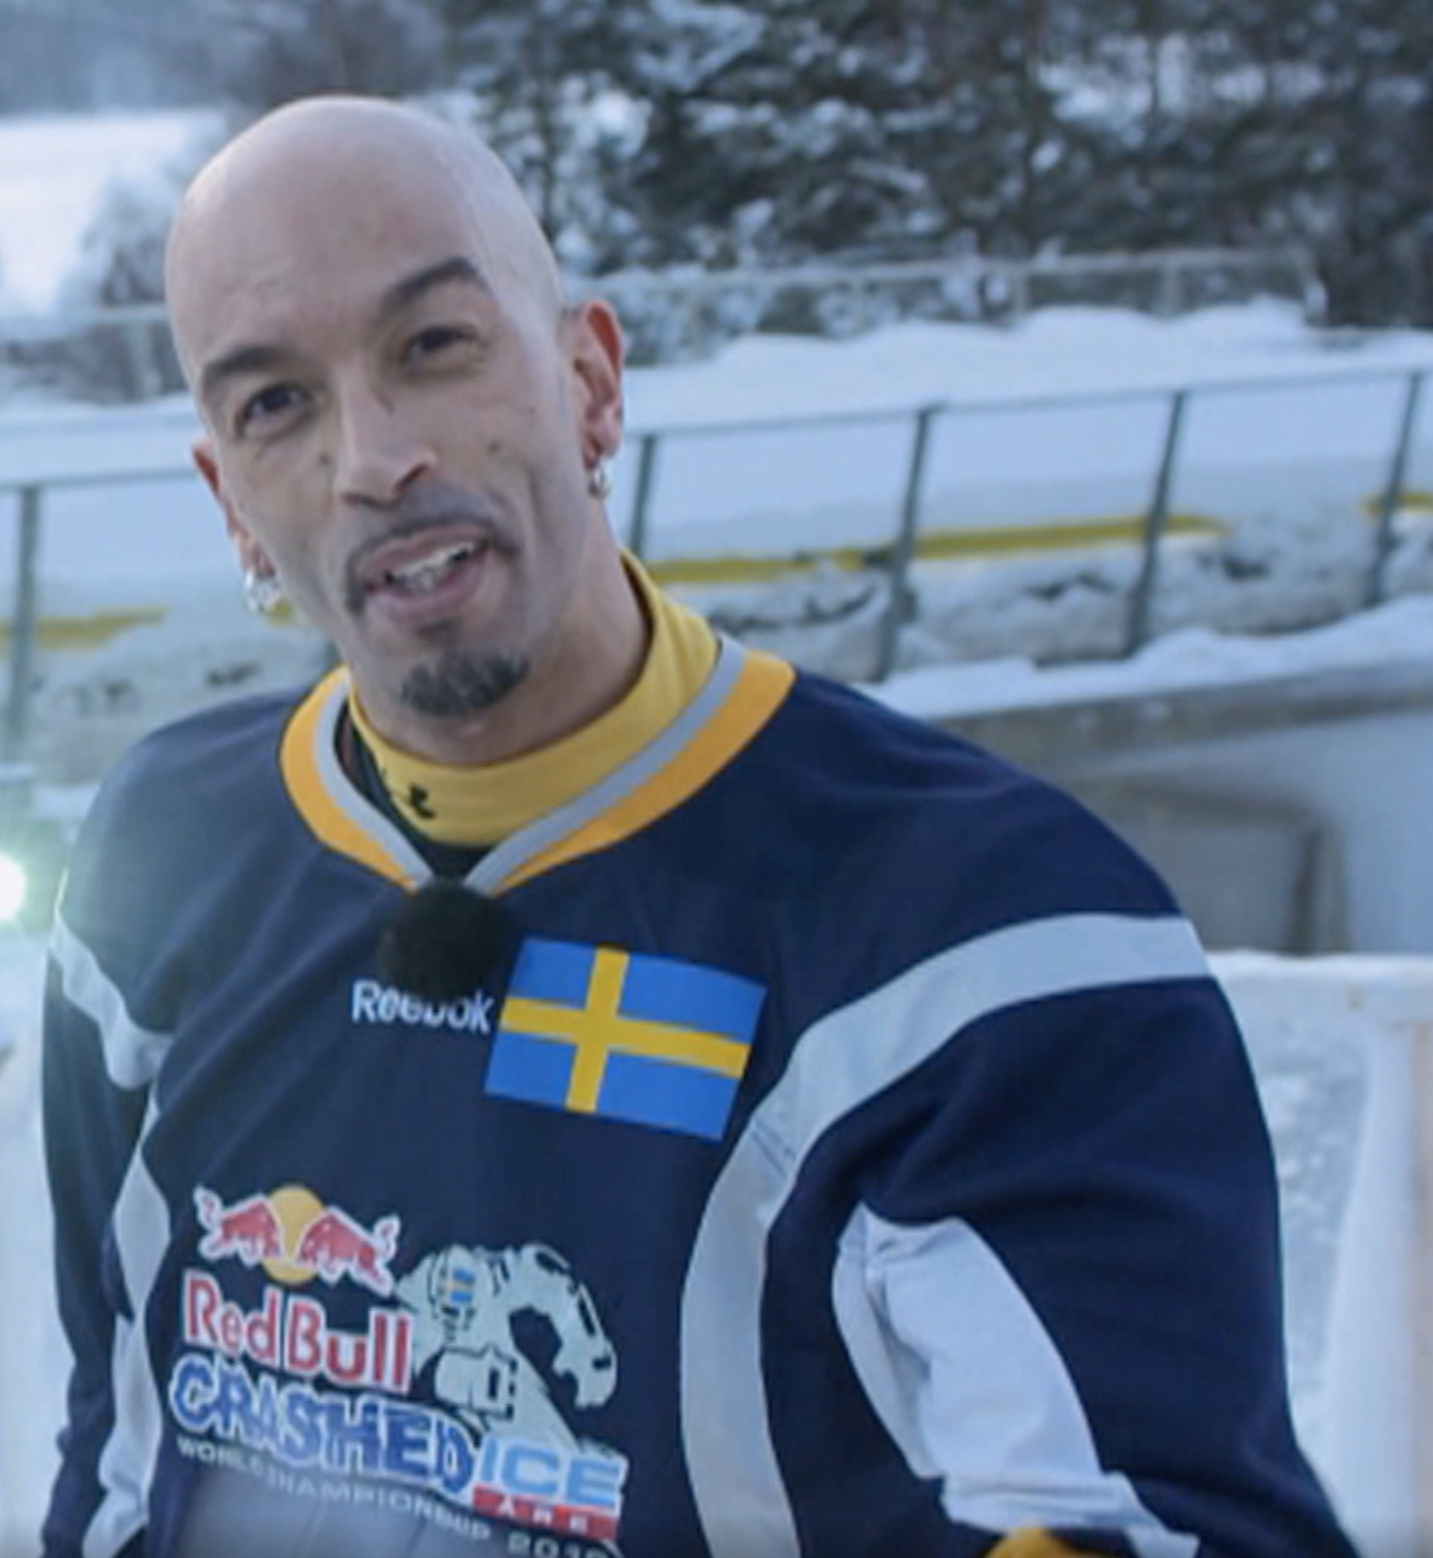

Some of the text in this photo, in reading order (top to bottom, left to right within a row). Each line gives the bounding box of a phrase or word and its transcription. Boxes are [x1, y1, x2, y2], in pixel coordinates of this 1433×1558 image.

[184, 1271, 413, 1394] Red Bull
[170, 1355, 625, 1504] CRASHED ICE
